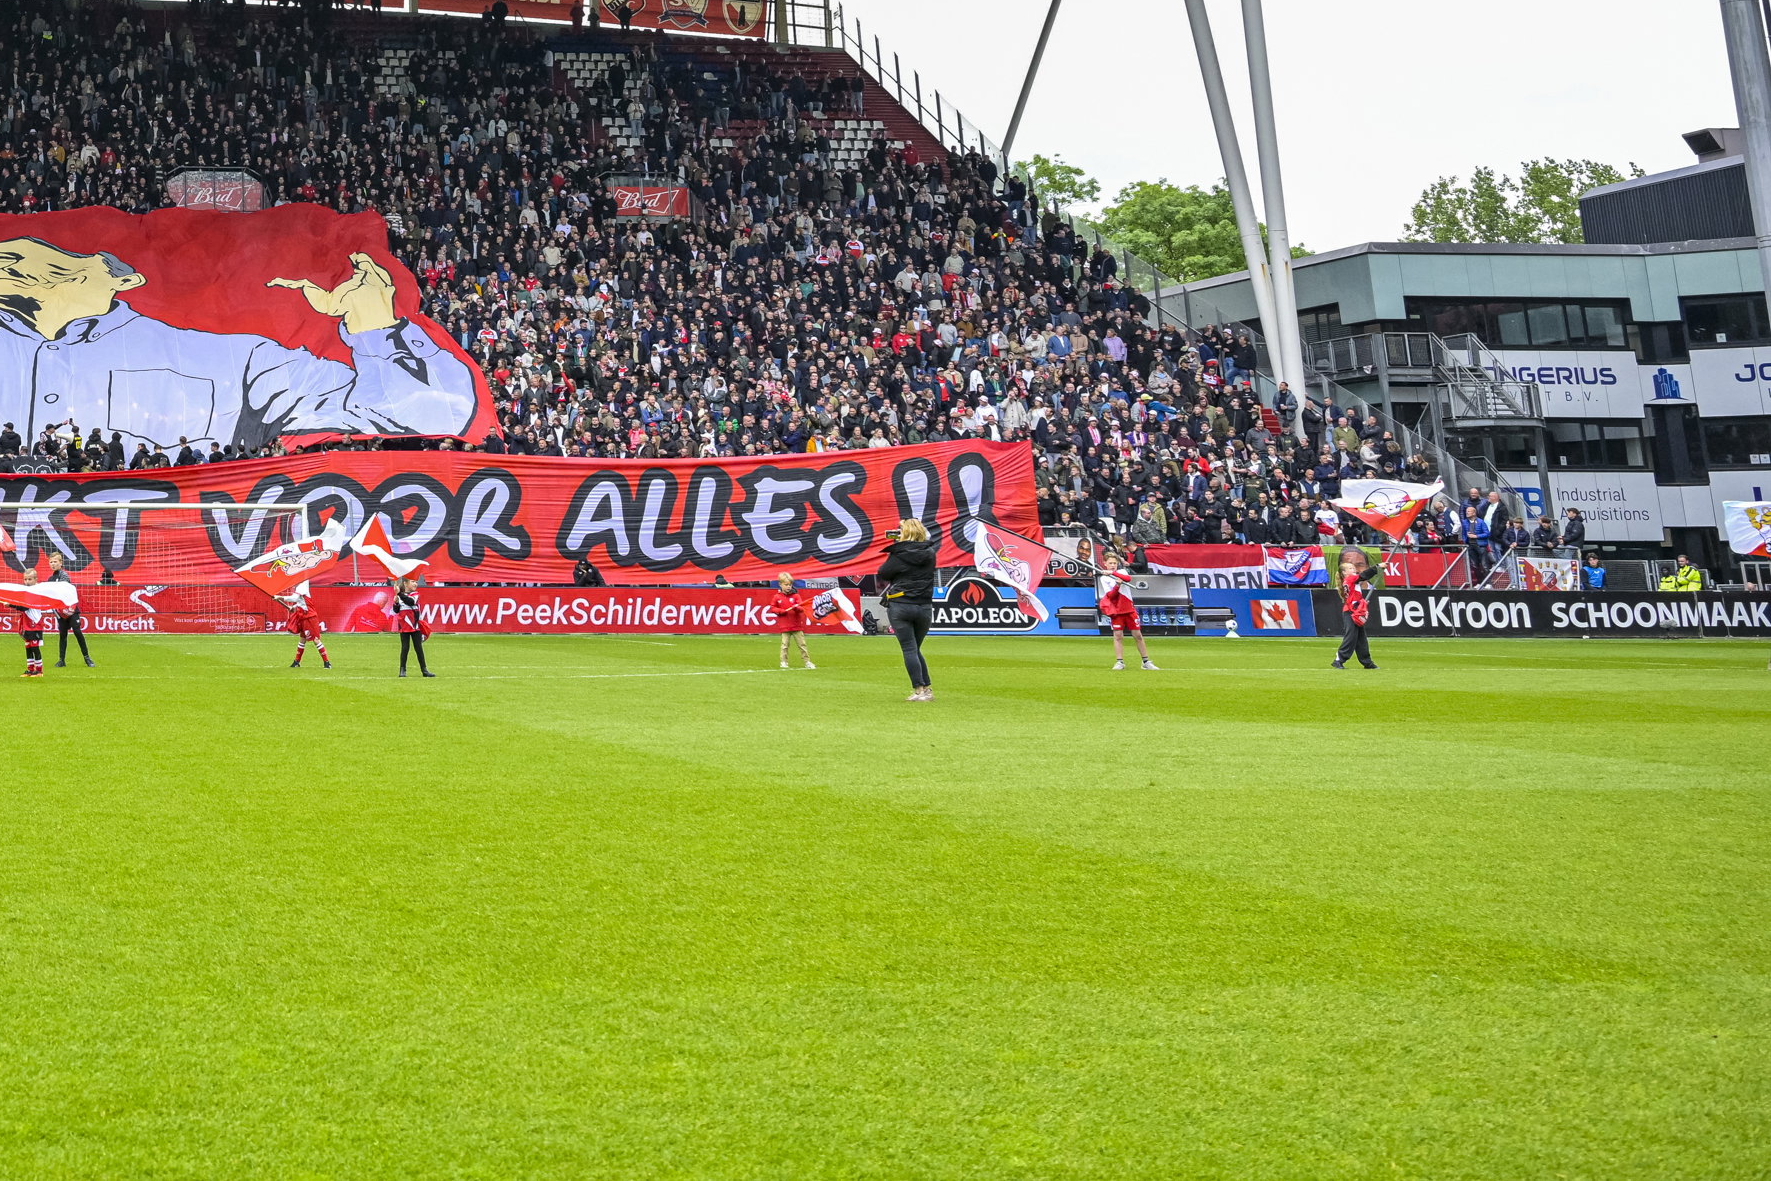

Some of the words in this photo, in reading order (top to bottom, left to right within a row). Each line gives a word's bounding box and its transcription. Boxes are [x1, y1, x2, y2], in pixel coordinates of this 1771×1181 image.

[190, 186, 233, 203] Bud
[618, 191, 660, 208] Bud
[1556, 487, 1627, 503] Industrial
[564, 472, 864, 562] ALLES
[1559, 507, 1650, 522] Aquisitions
[95, 615, 155, 631] Utrecht
